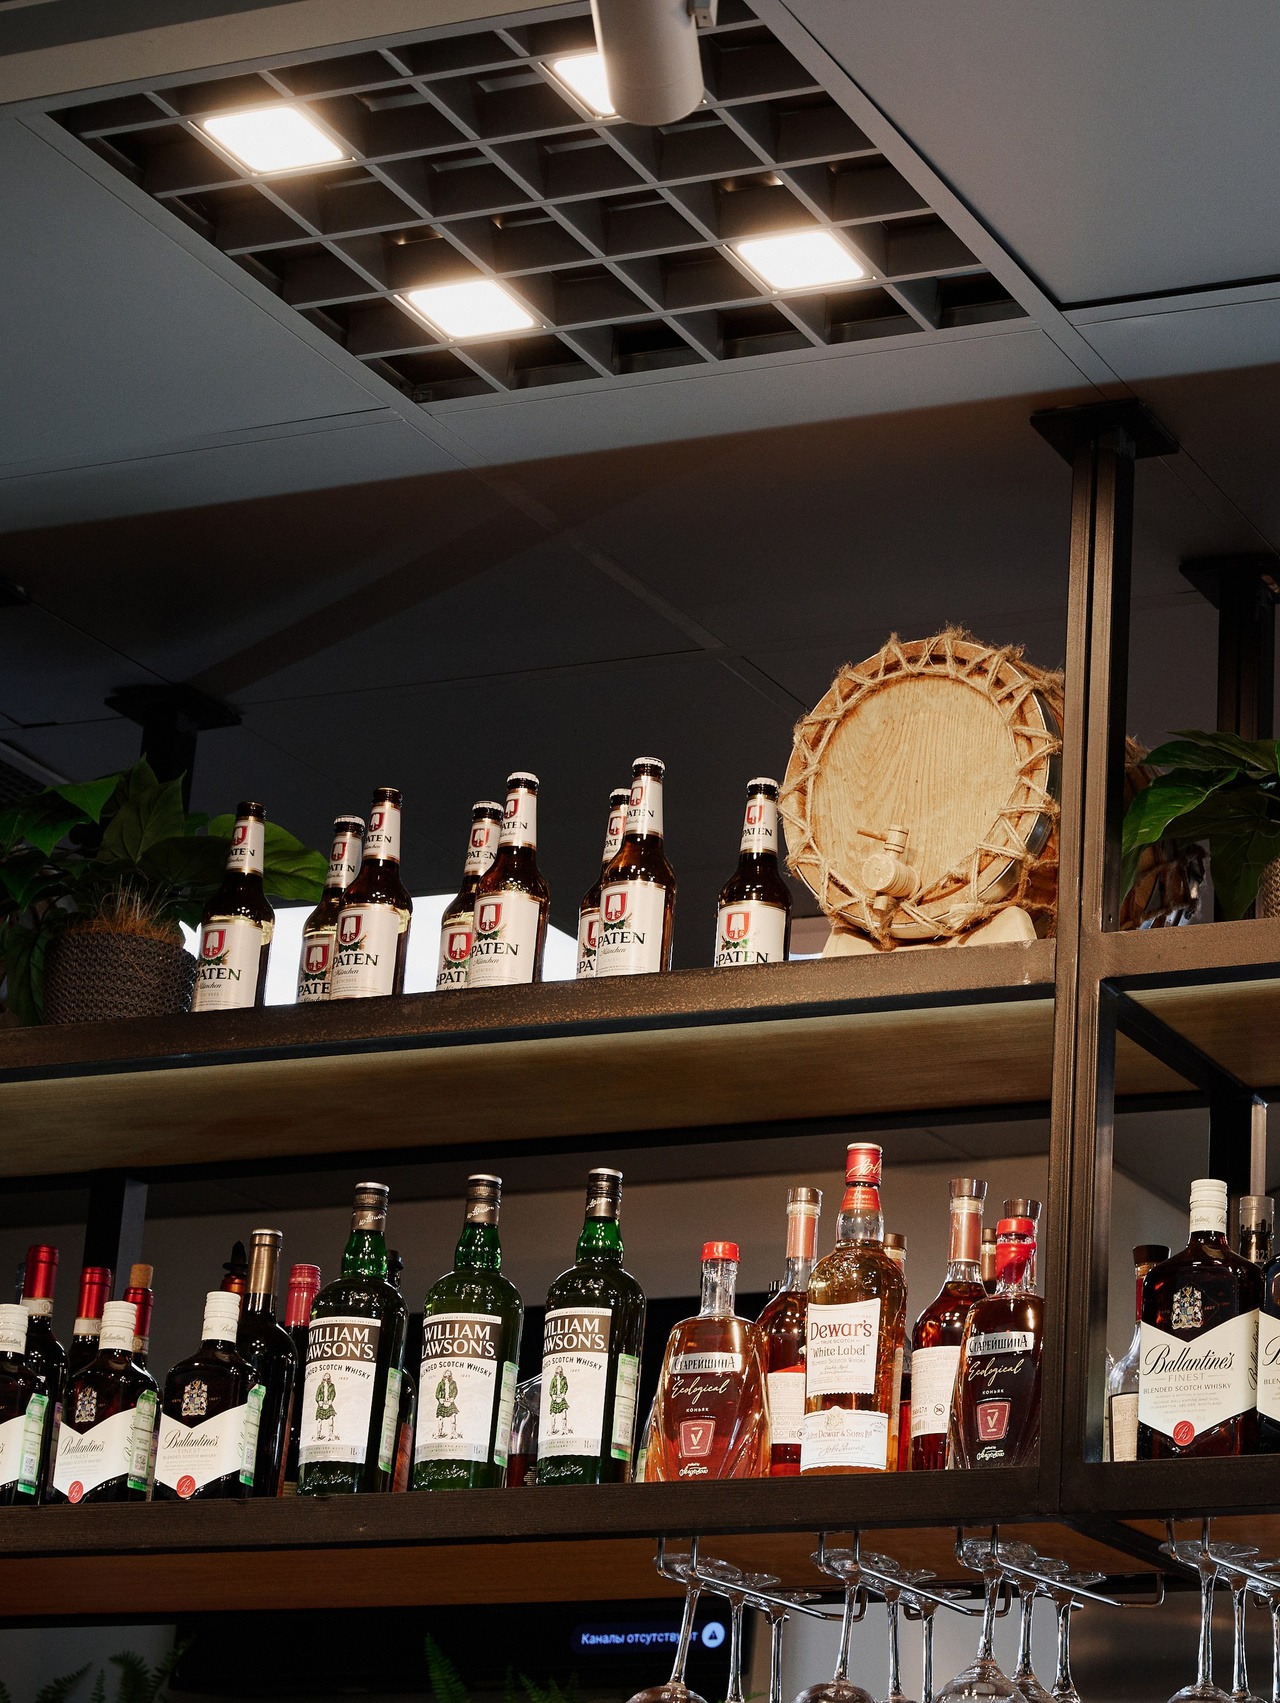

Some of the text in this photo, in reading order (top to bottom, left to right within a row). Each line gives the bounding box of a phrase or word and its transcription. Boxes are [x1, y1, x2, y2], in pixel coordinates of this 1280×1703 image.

[308, 1326, 370, 1345] WILLIAM
[423, 1323, 491, 1342] WILLIAM
[551, 1356, 603, 1371] SCOTCH WHISKY
[1143, 1343, 1235, 1376] Ballantine's
[318, 1364, 371, 1380] SCOTCH WHISKY
[438, 1361, 465, 1370] SCOTCH
[466, 1362, 493, 1378] WHISKY
[968, 1357, 1025, 1387] Ecological
[1168, 1373, 1205, 1382] FINEST
[671, 1376, 731, 1405] Ecological
[1143, 1386, 1172, 1395] BLENDED
[164, 1429, 219, 1449] Ballantine's
[581, 1631, 698, 1646] Каналы отсутствут
